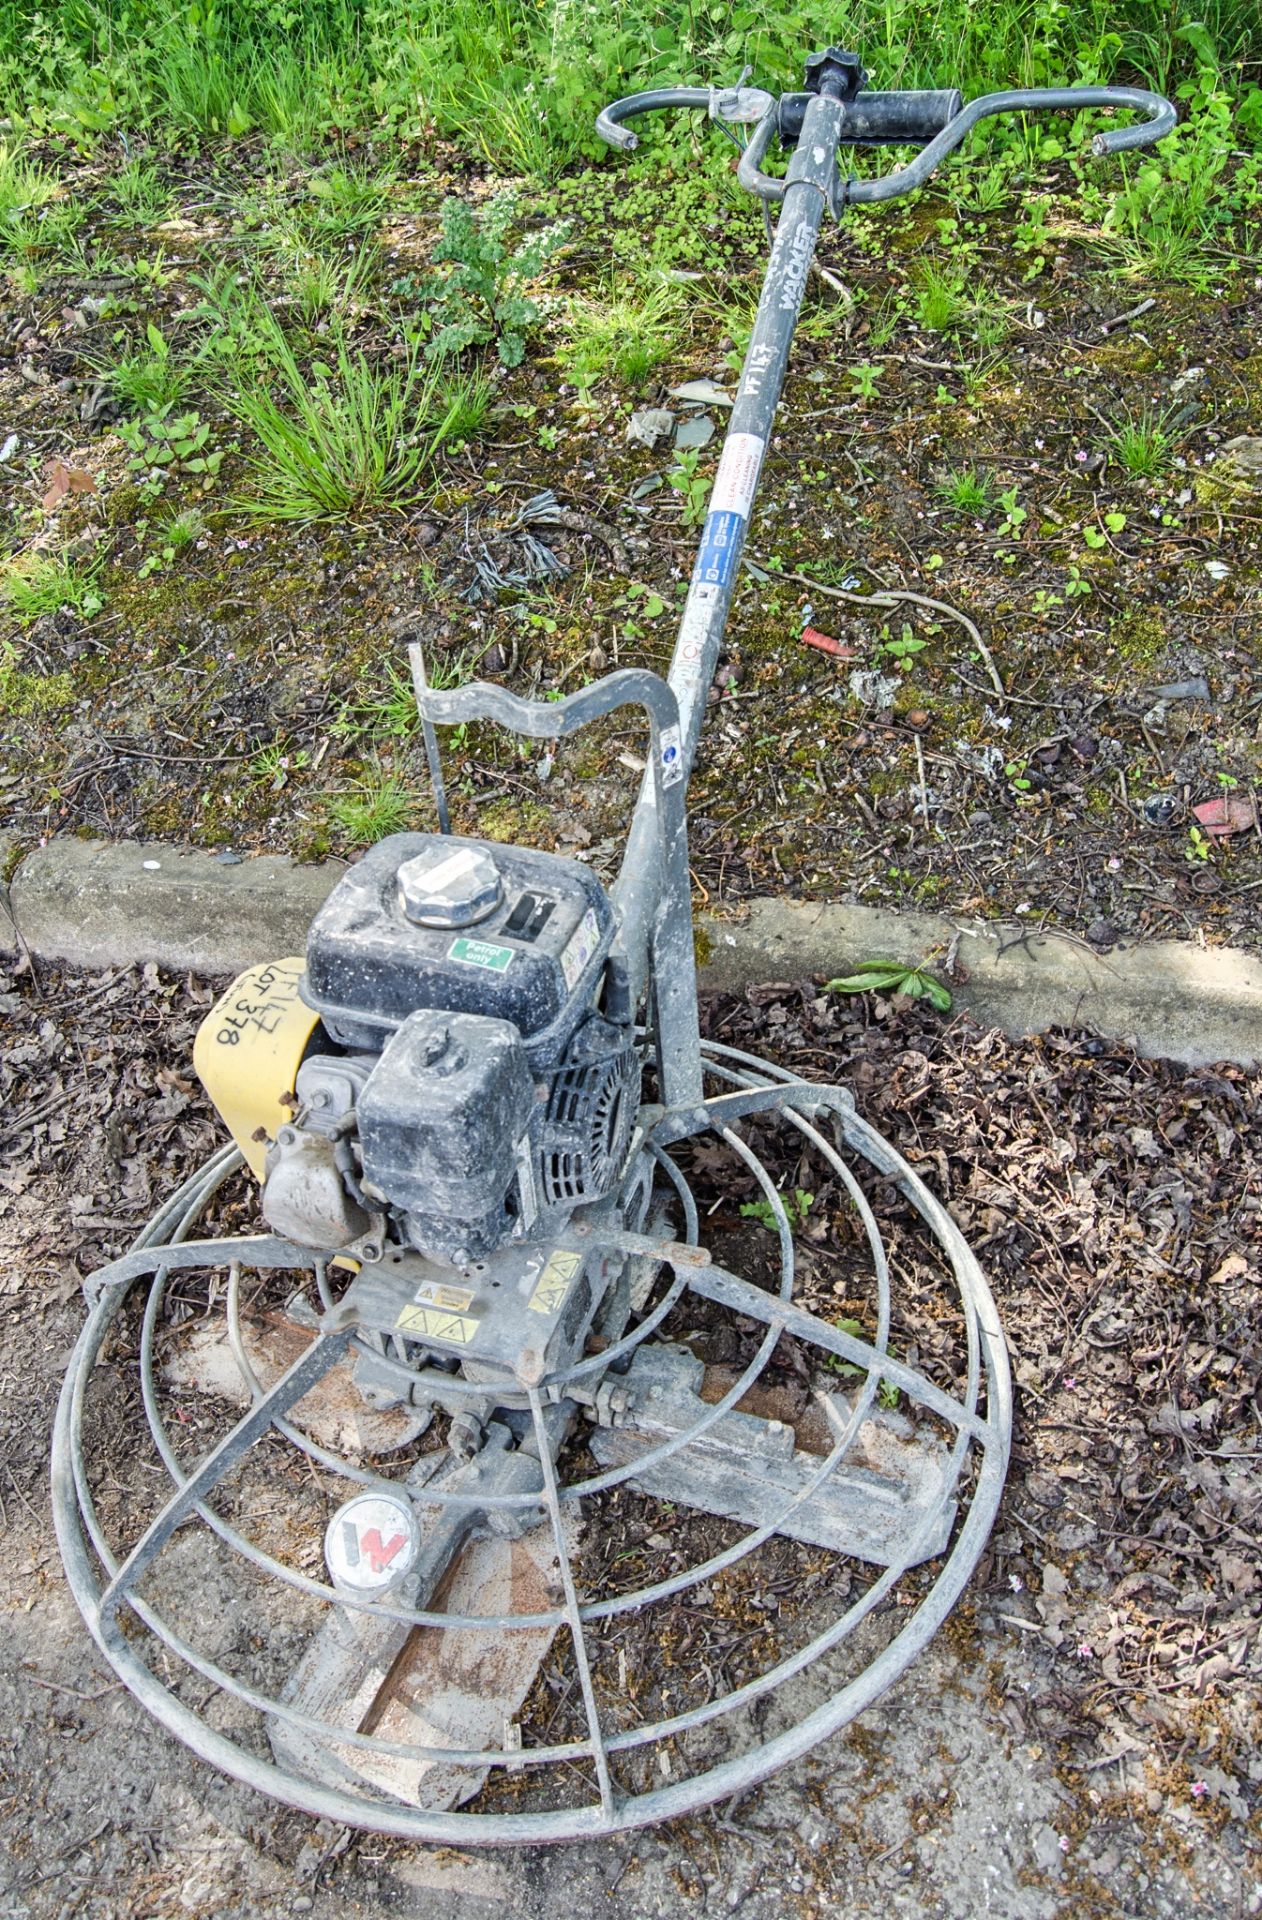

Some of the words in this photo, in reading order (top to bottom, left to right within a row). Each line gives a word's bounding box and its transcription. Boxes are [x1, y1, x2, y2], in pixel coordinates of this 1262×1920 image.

[778, 220, 813, 310] WACKER
[466, 942, 503, 957] Petrol
[466, 951, 492, 965] only
[252, 965, 287, 996] LOT
[217, 999, 257, 1046] 378
